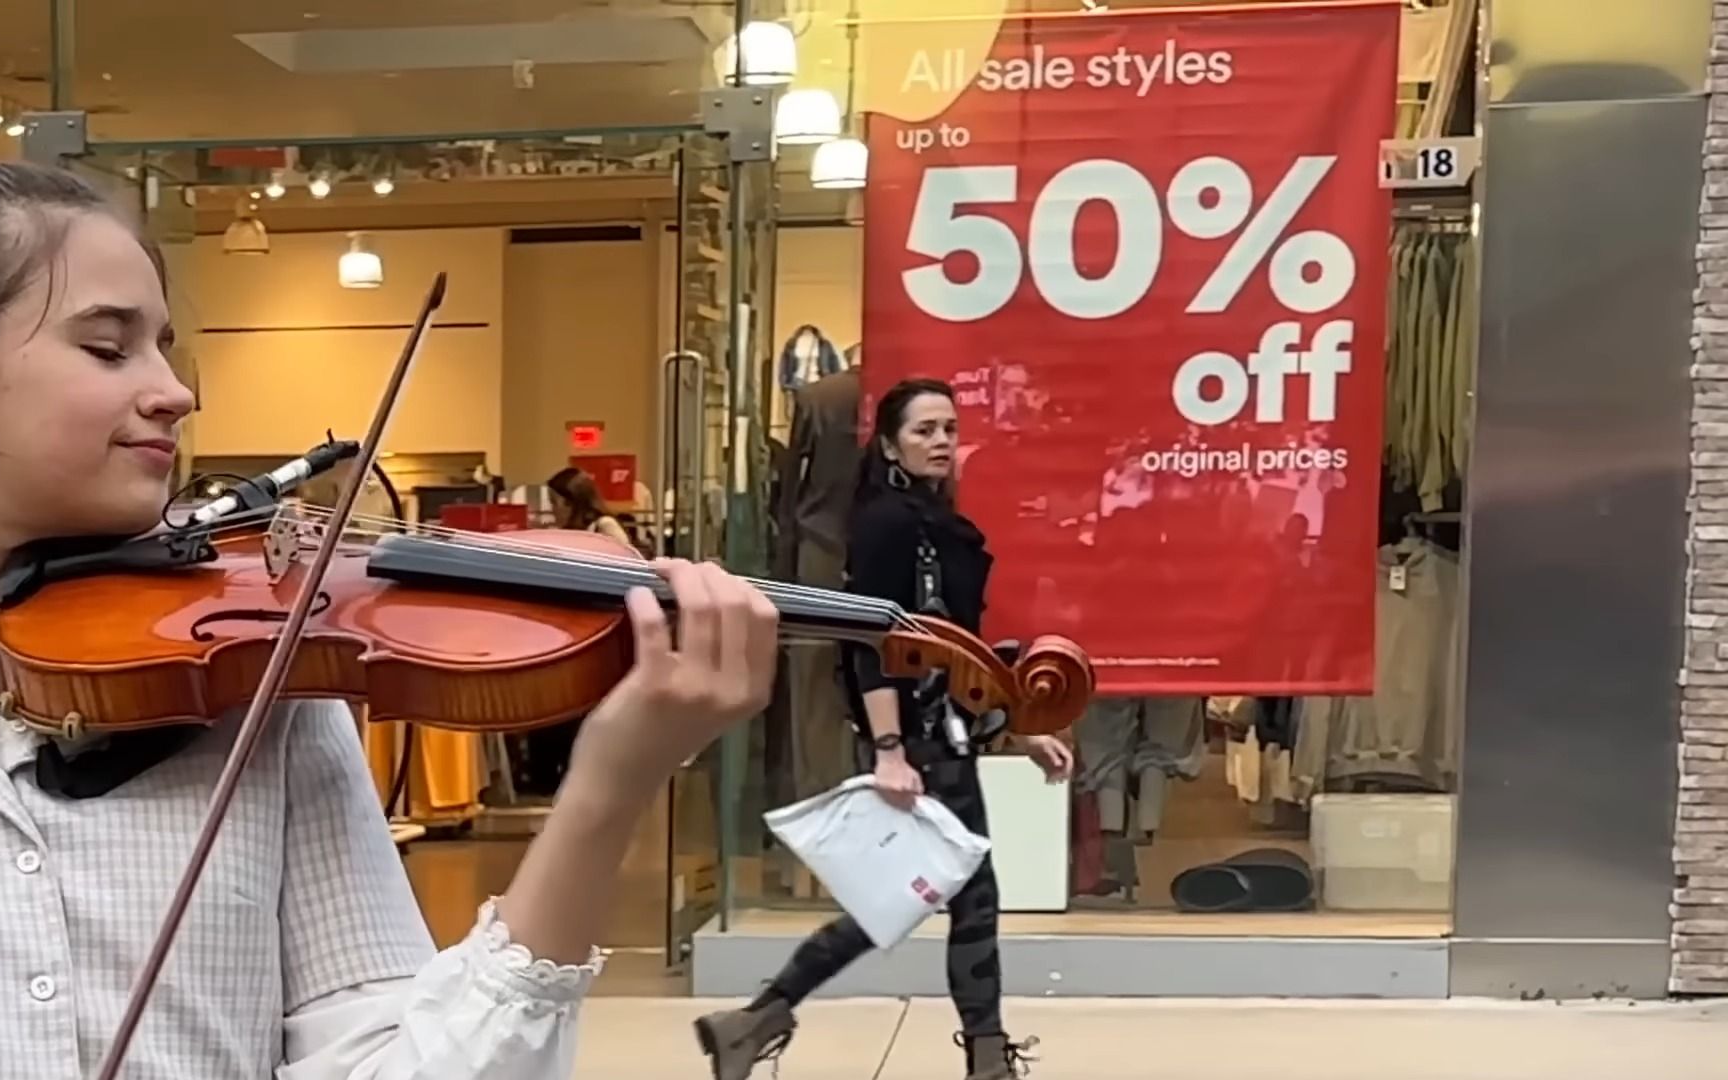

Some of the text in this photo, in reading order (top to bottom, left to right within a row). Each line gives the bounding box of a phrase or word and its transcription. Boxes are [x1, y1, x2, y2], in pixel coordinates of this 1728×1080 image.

[900, 38, 1234, 97] All sale styles
[896, 124, 971, 153] up to
[900, 155, 1356, 322] 50%
[1172, 321, 1354, 426] off
[1141, 442, 1348, 475] original prices
